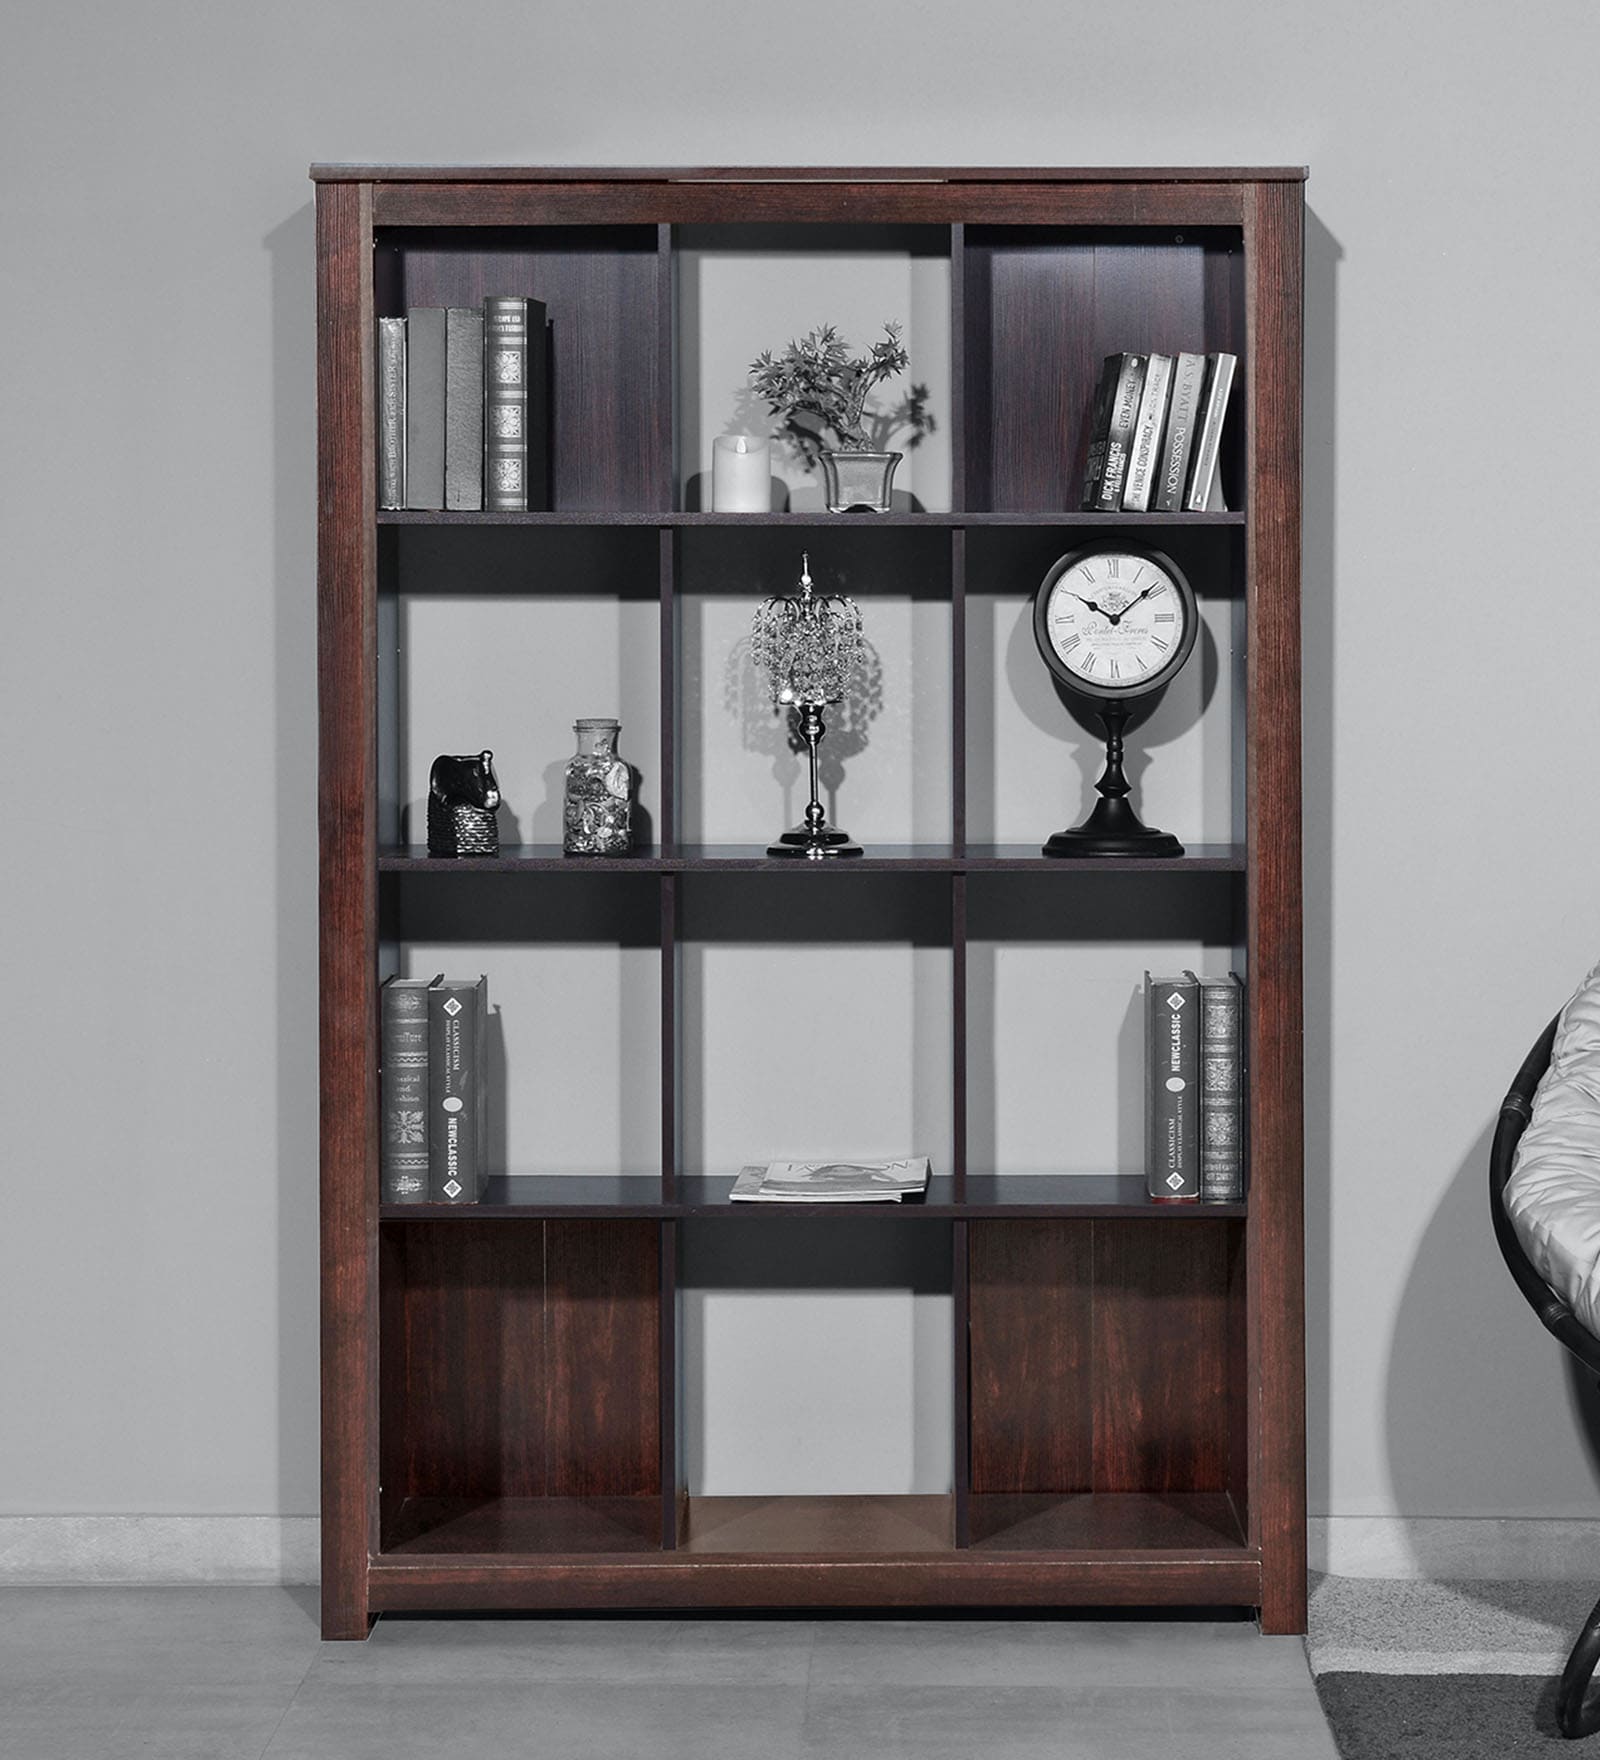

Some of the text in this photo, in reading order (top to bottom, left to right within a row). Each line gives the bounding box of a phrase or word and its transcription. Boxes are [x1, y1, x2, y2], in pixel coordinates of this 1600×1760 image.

[1118, 378, 1136, 429] EVEN MONEY
[1177, 384, 1192, 421] BYATT
[1101, 441, 1122, 501] DICK FRANCIS
[1136, 424, 1154, 467] CONSPIRACY
[1167, 427, 1186, 494] POSSESSION
[1132, 467, 1146, 492] VENICE
[1171, 1013, 1181, 1072] NEWCLASSIC
[447, 1117, 458, 1177] NEWCLASSIC
